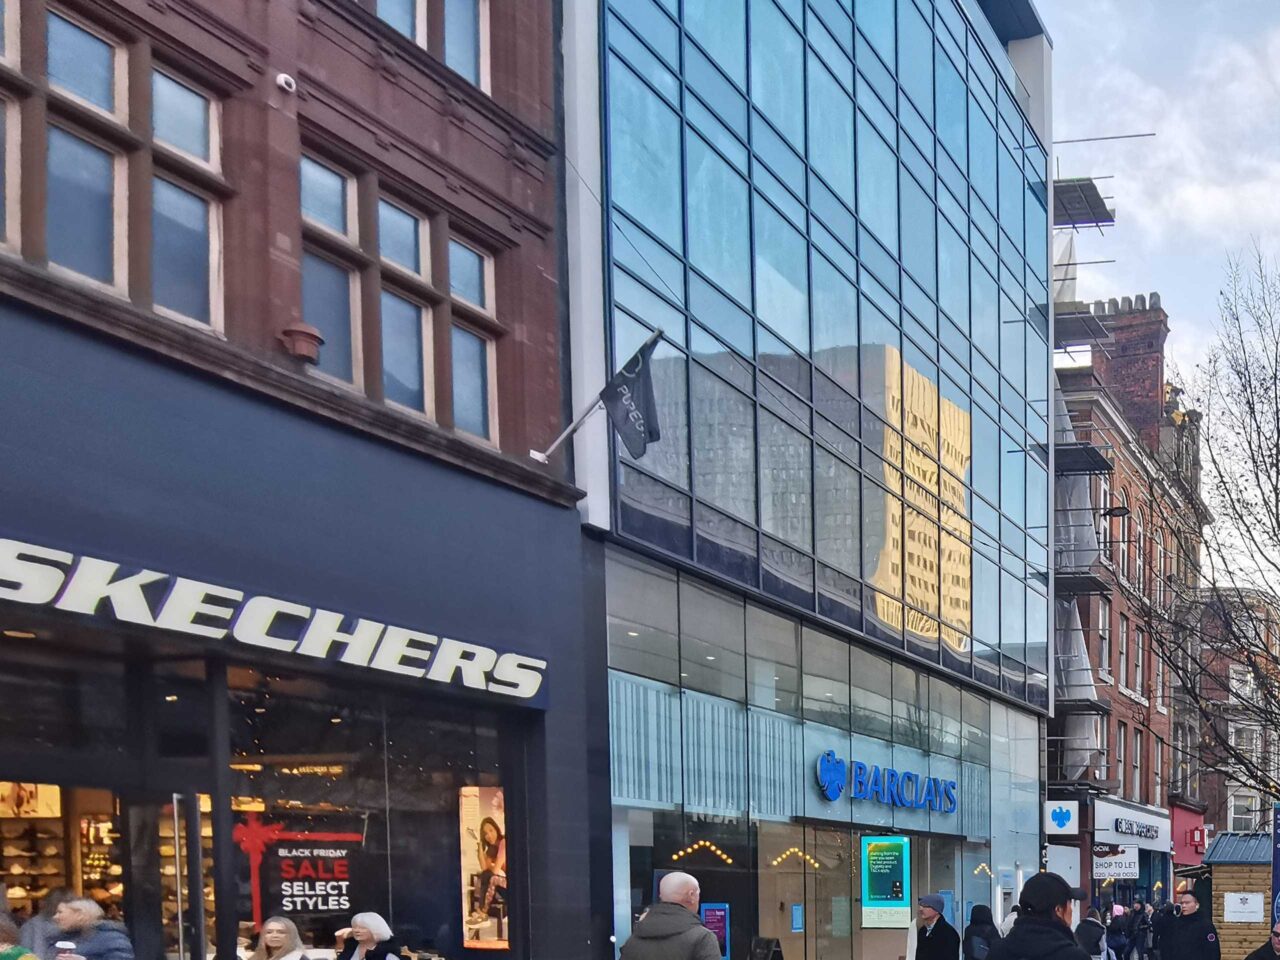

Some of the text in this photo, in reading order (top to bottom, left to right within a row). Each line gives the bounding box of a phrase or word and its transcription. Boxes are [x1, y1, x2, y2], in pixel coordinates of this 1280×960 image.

[0, 538, 548, 698] SKECHERS
[850, 760, 957, 814] BARCLAYS
[278, 848, 348, 857] BLACK FRIDAY
[280, 858, 350, 880] SALE
[1095, 861, 1136, 869] SHOP TO LET
[281, 881, 350, 895] SELECT
[282, 896, 351, 911] STYLES
